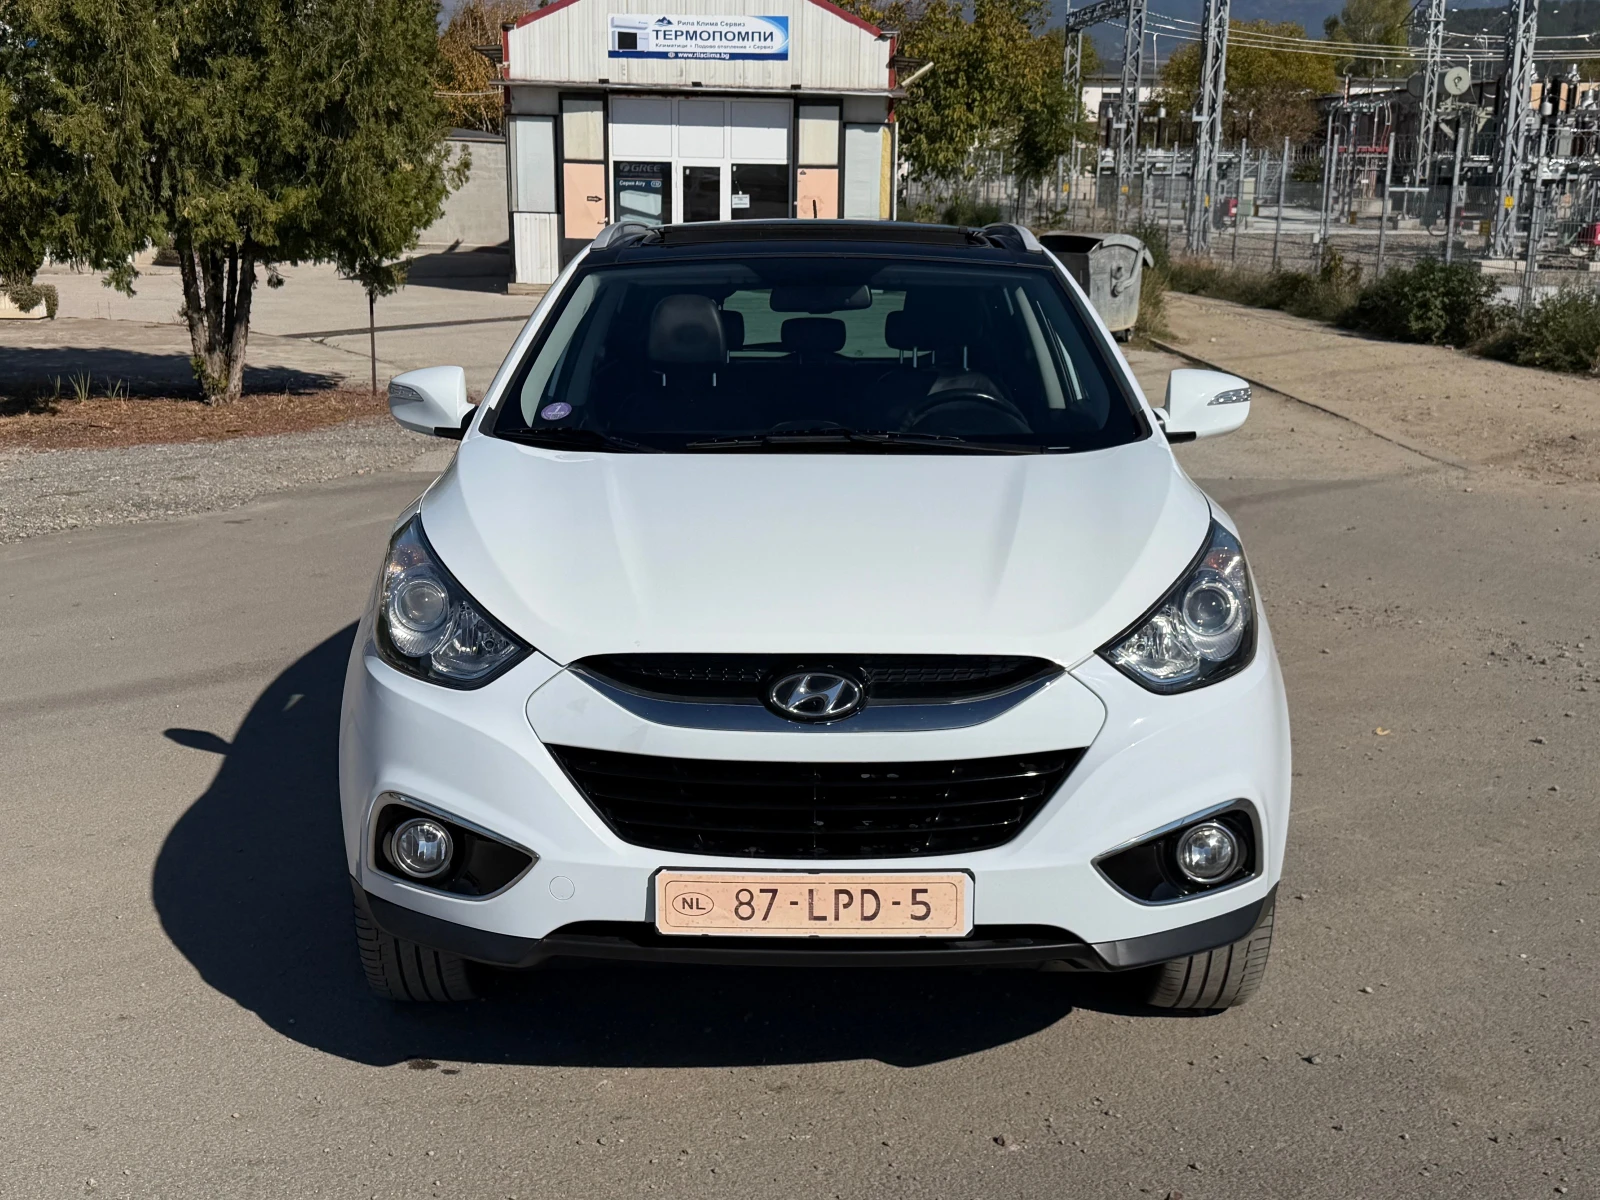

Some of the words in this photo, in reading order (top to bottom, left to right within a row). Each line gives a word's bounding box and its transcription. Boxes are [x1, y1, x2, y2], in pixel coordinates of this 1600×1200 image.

[720, 20, 746, 28] Сервиз
[652, 29, 774, 42] ТЕРМОПОМПИ
[678, 52, 730, 60] www.rilaclima.bg
[631, 163, 661, 173] GREE
[681, 897, 707, 911] NL
[733, 887, 932, 922] 87-LPD-5
